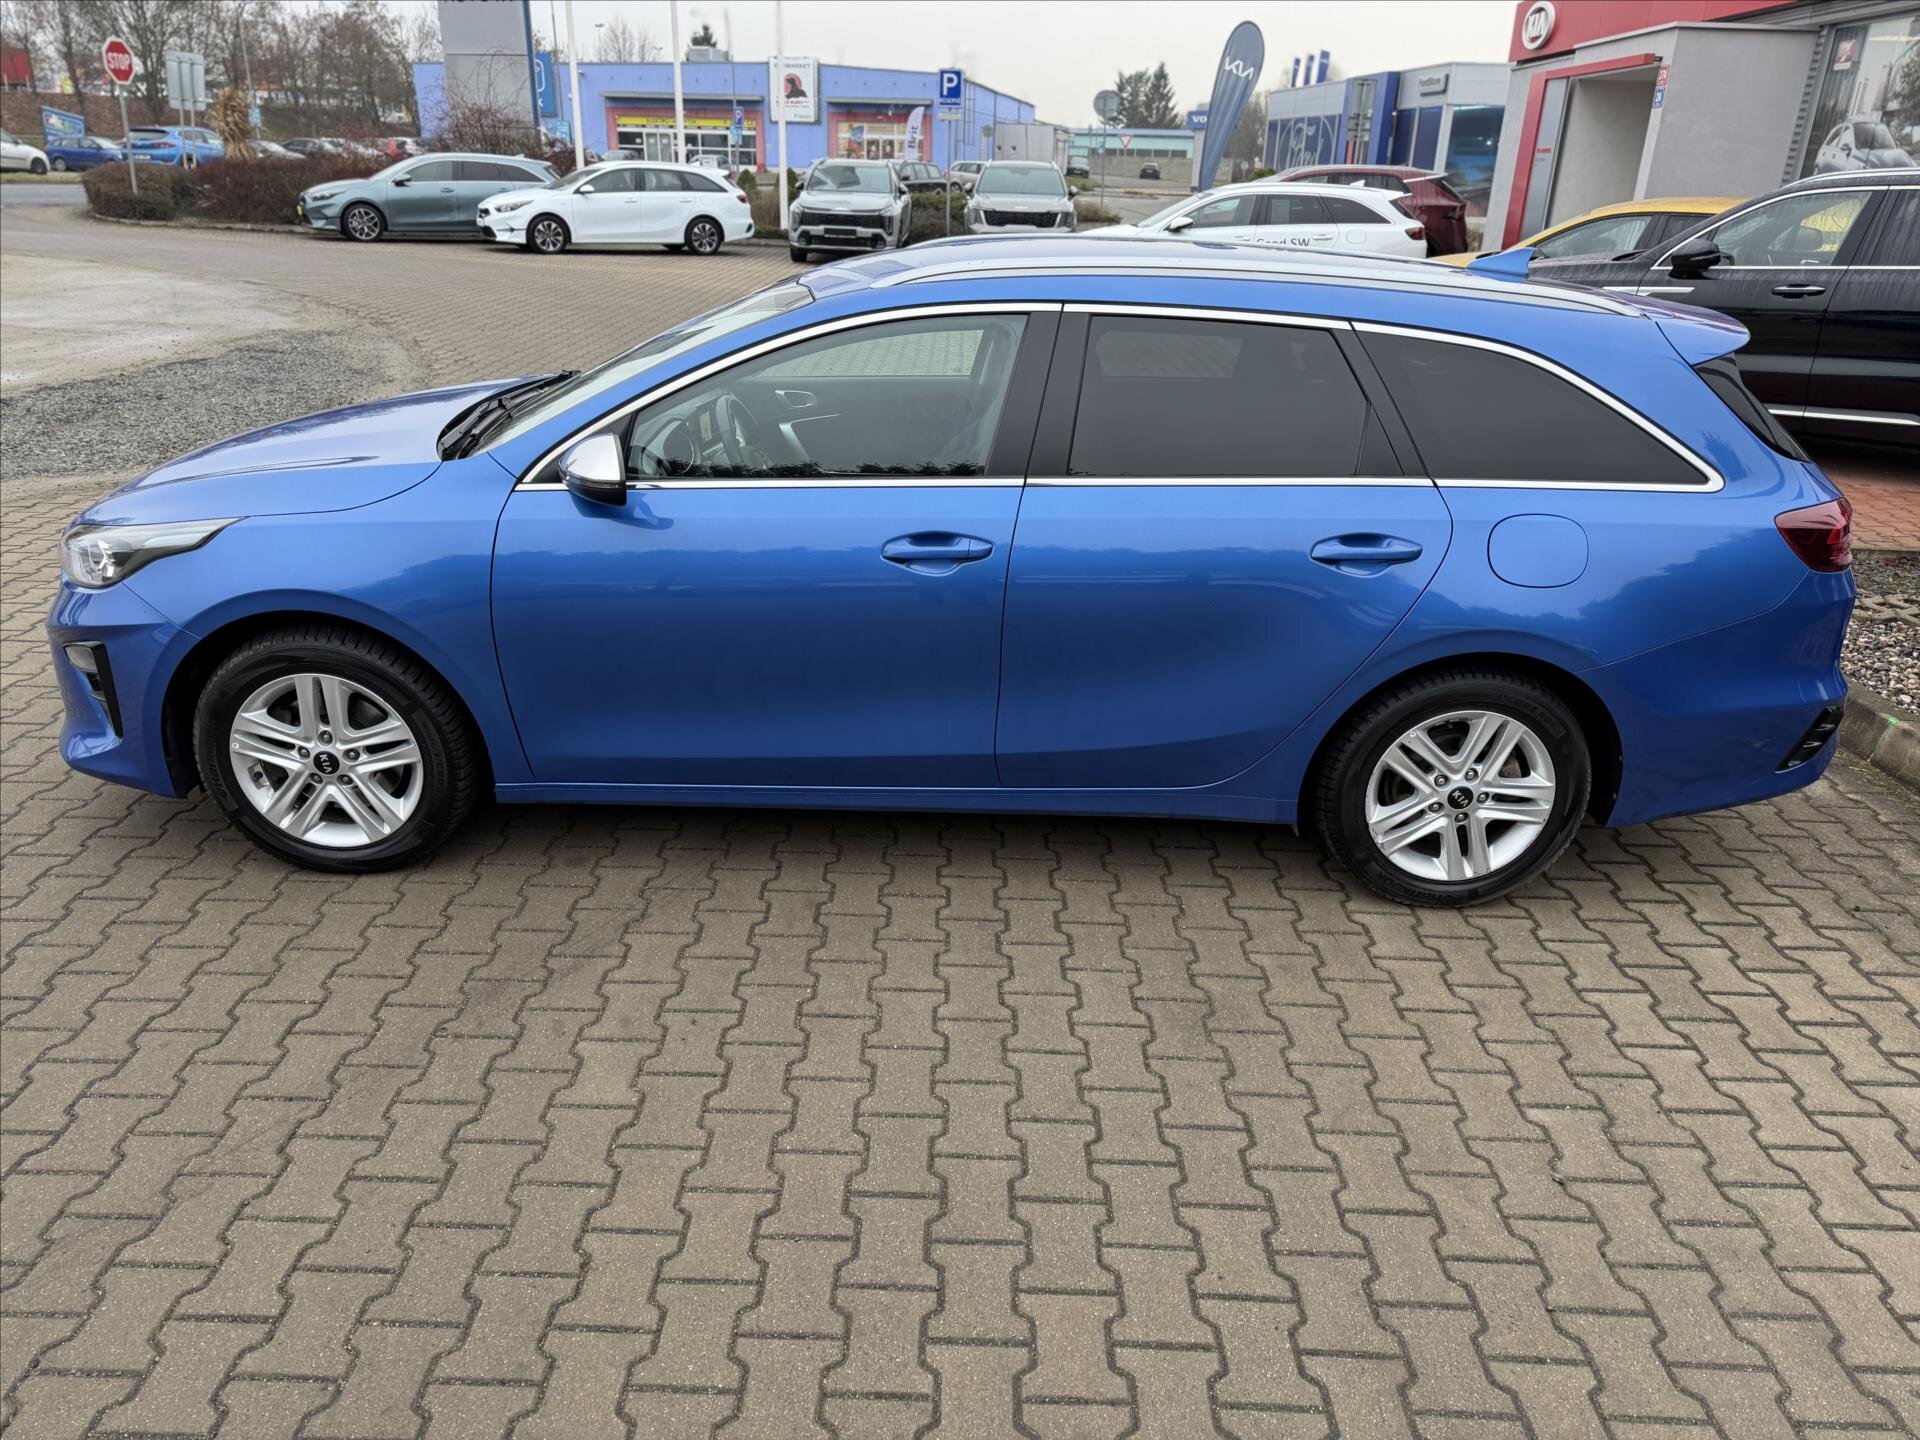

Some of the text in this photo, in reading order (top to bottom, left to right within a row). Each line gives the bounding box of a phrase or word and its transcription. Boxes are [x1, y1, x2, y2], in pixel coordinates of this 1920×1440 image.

[107, 51, 130, 70] STOP
[1225, 56, 1254, 80] KIA
[943, 73, 958, 95] P
[319, 753, 333, 774] KIA
[1451, 790, 1469, 808] KIA
